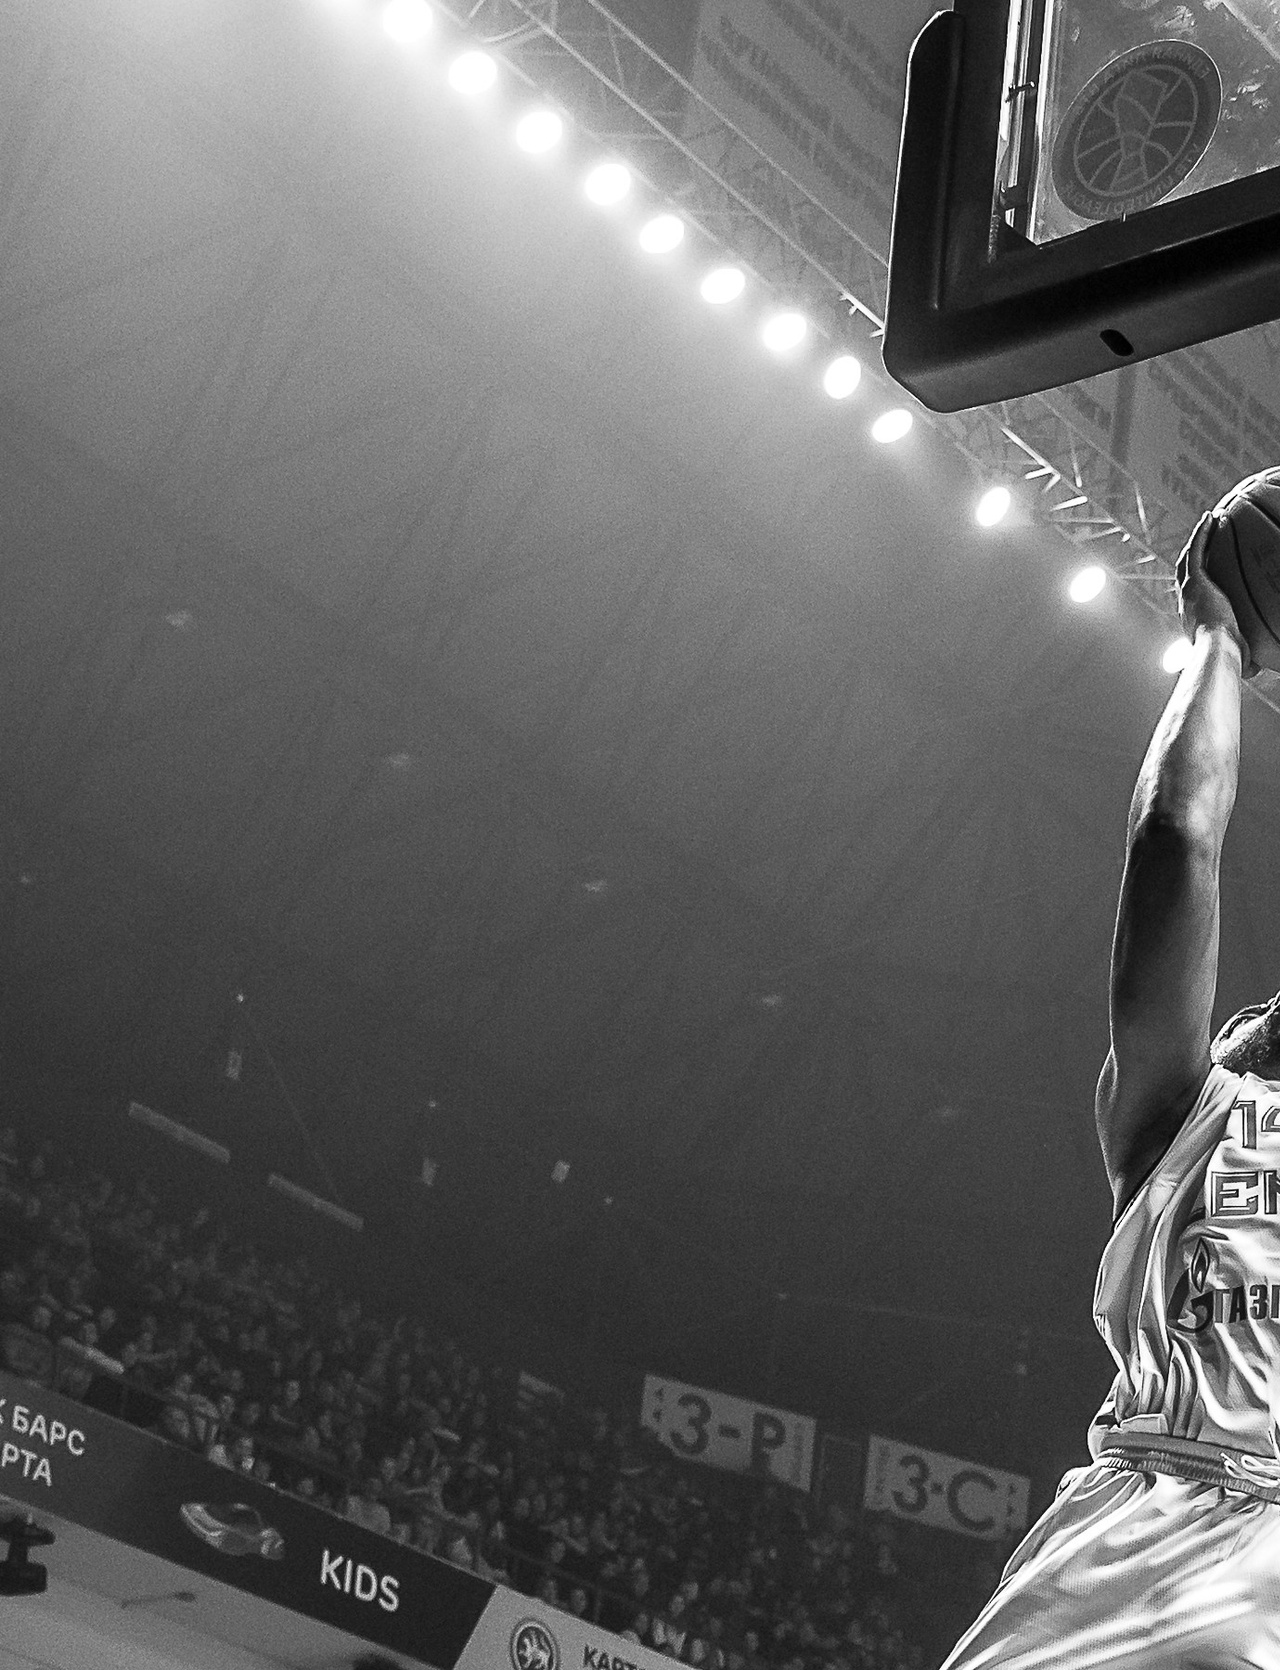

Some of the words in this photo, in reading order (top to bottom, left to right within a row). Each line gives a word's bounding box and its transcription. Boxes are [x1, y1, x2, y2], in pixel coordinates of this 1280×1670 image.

[12, 1405, 86, 1456] БАРС
[1, 1442, 53, 1487] РТА
[320, 1548, 400, 1612] KIDS
